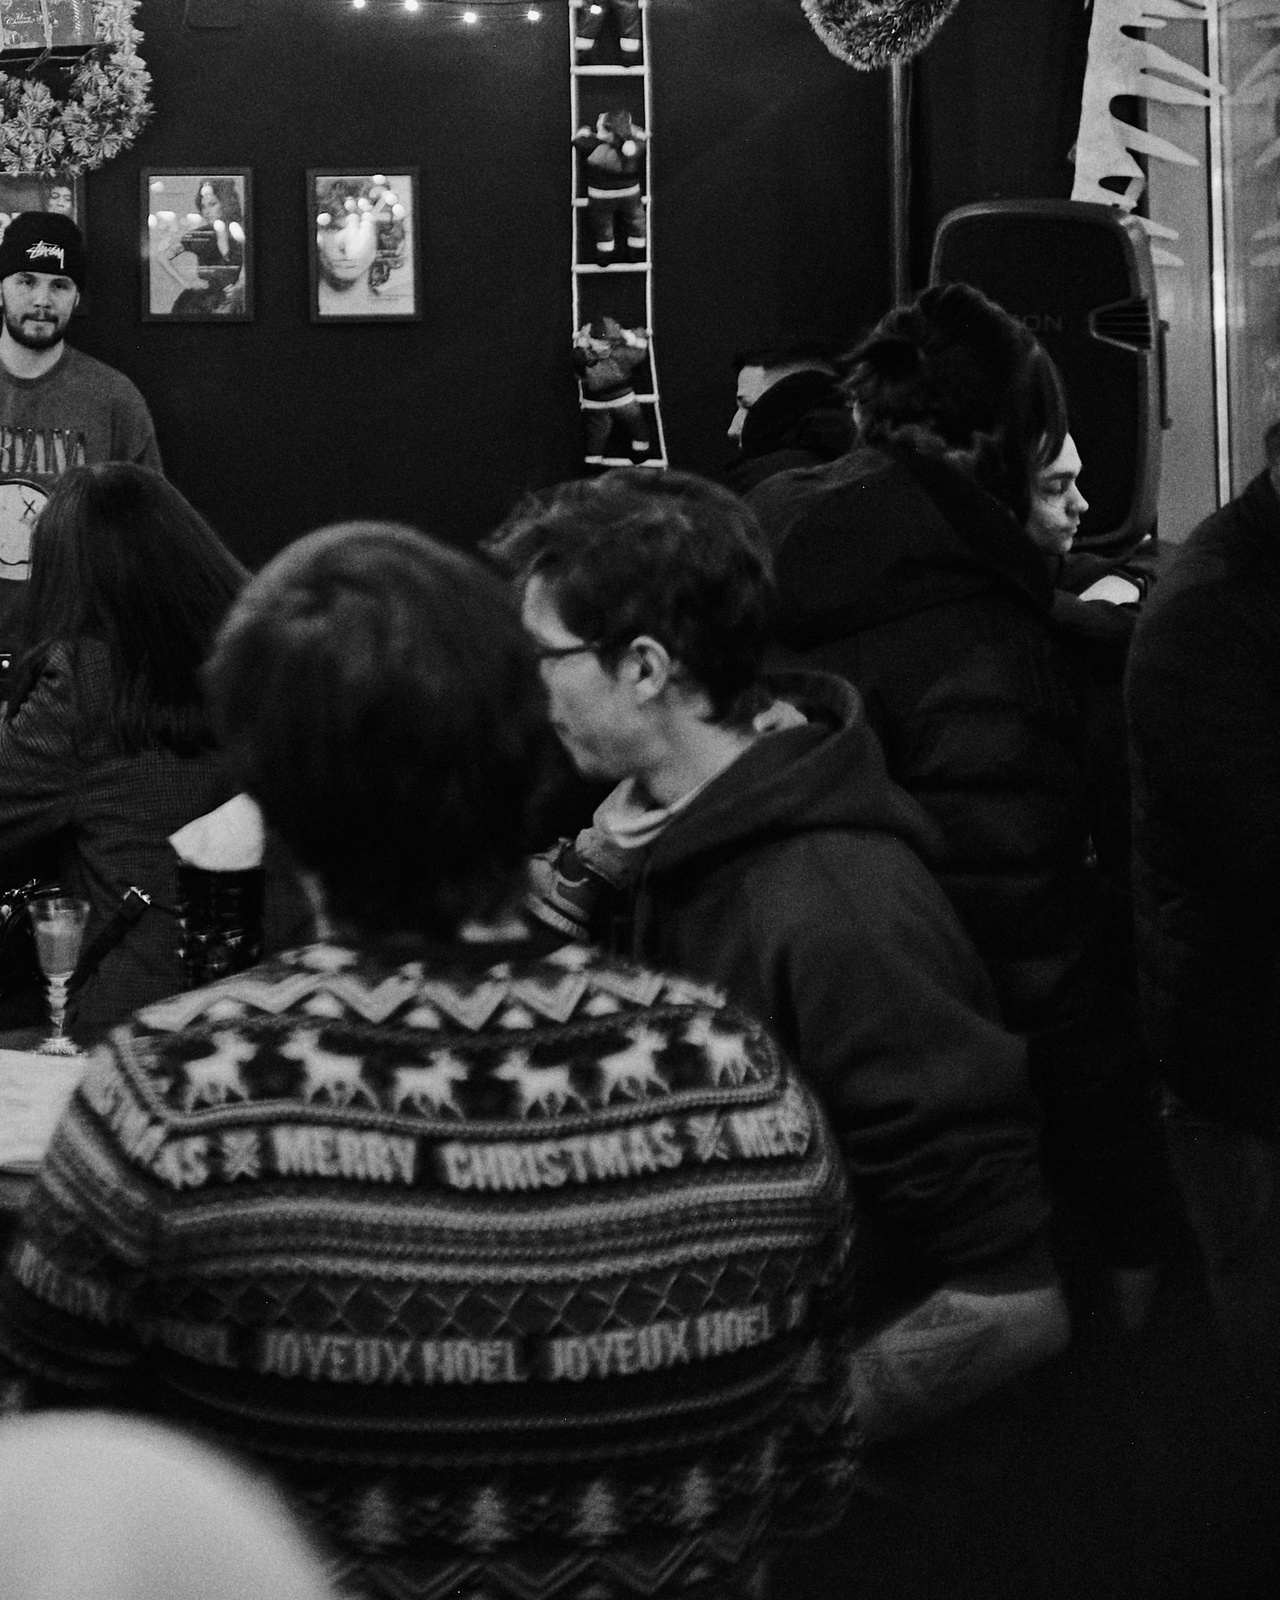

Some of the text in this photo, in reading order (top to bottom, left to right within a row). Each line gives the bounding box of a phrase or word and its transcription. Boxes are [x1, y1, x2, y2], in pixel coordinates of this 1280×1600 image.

[272, 1124, 418, 1185] MERRY
[441, 1119, 684, 1191] CHRISTMAS
[260, 1328, 416, 1384] JOYEUX
[421, 1336, 528, 1384] NOEL
[547, 1317, 690, 1381] JOYEUX
